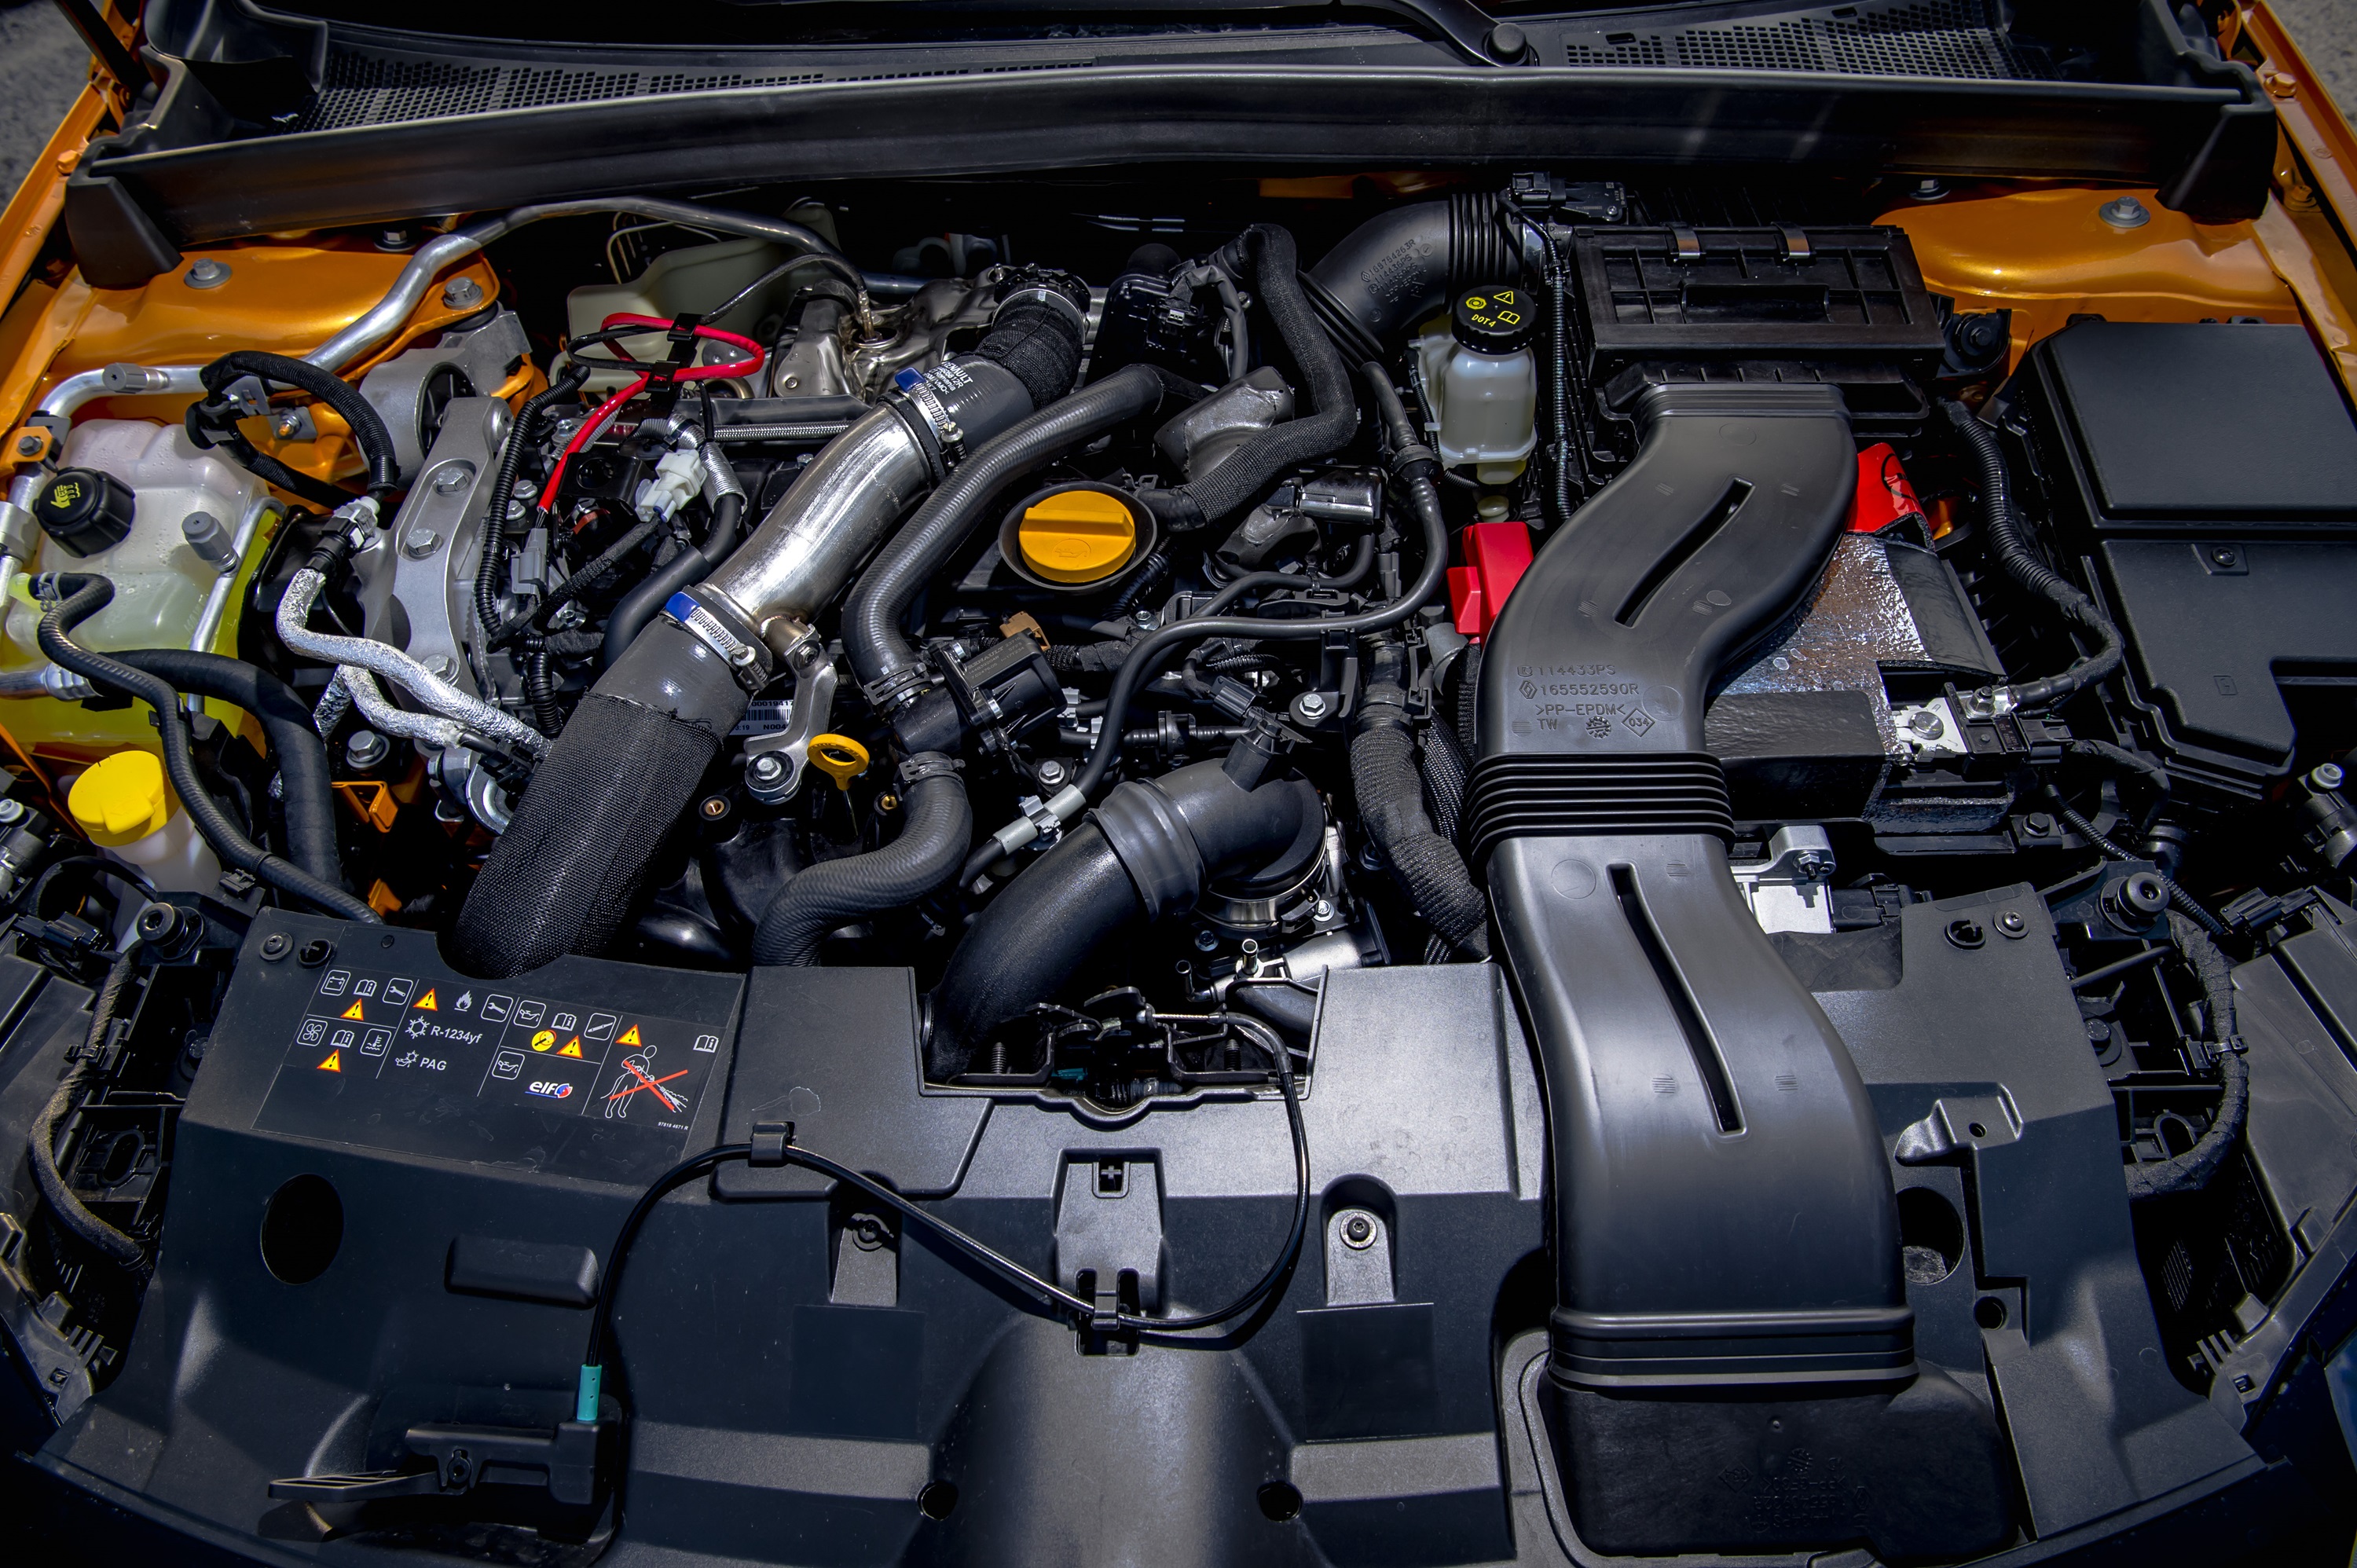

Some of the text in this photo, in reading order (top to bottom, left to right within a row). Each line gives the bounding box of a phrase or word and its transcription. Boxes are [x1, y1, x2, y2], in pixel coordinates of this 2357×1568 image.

[934, 372, 956, 391] Romania
[968, 646, 1003, 669] RENAULT
[1539, 665, 1616, 676] 114433PS
[1540, 683, 1640, 696] 165552590R
[1535, 704, 1626, 716] >PP-EPDM<
[1537, 719, 1558, 731] TW
[1628, 717, 1650, 727] 034
[431, 1026, 482, 1044] R-1234yf
[420, 1057, 447, 1071] PAG
[530, 1081, 558, 1094] elf
